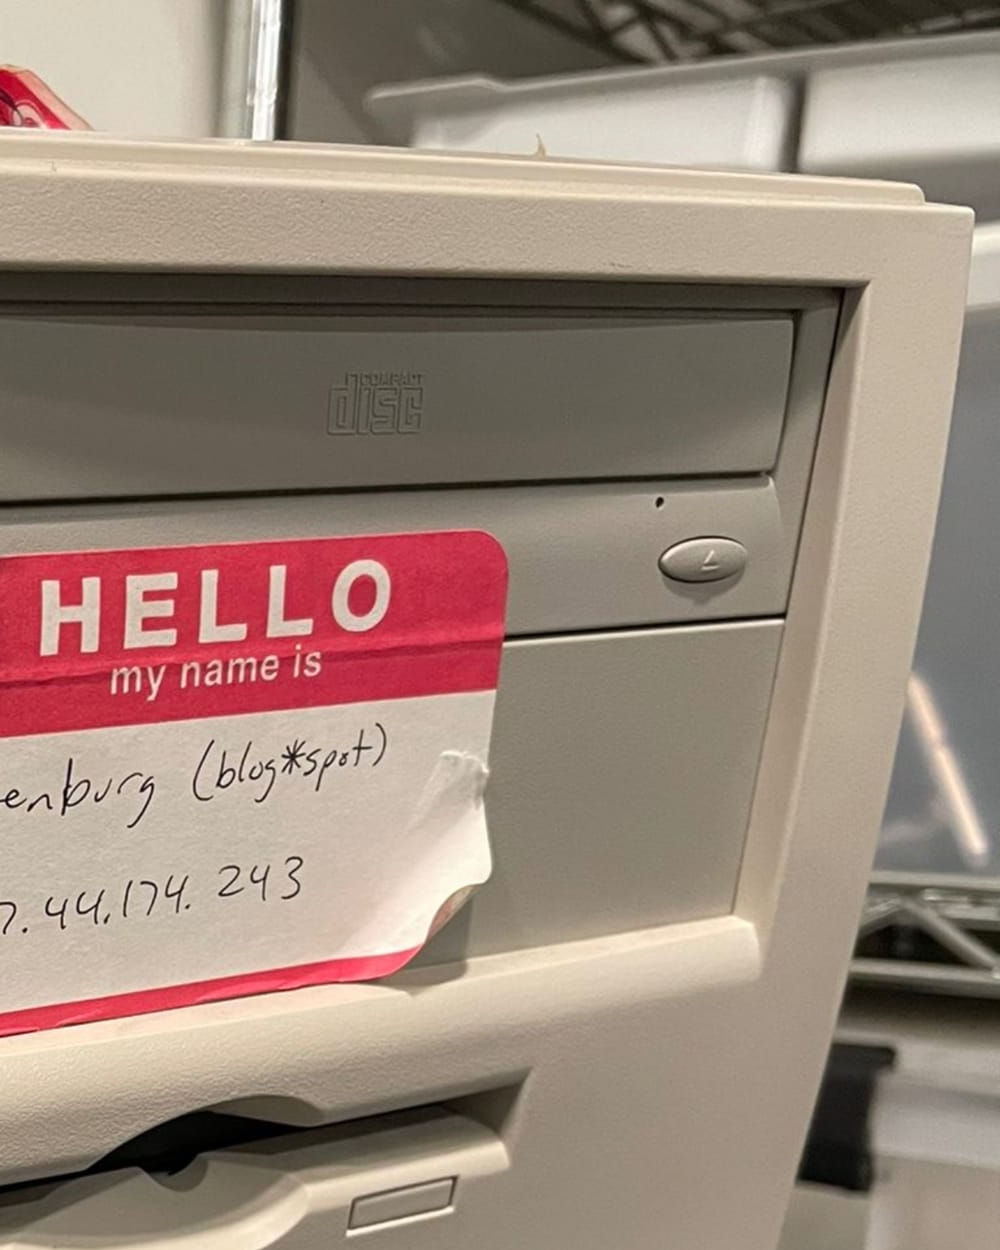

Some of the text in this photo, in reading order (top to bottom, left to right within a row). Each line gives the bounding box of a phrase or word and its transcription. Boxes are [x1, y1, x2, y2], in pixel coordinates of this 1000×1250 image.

[38, 558, 392, 657] HELLO
[109, 644, 322, 701] my name is
